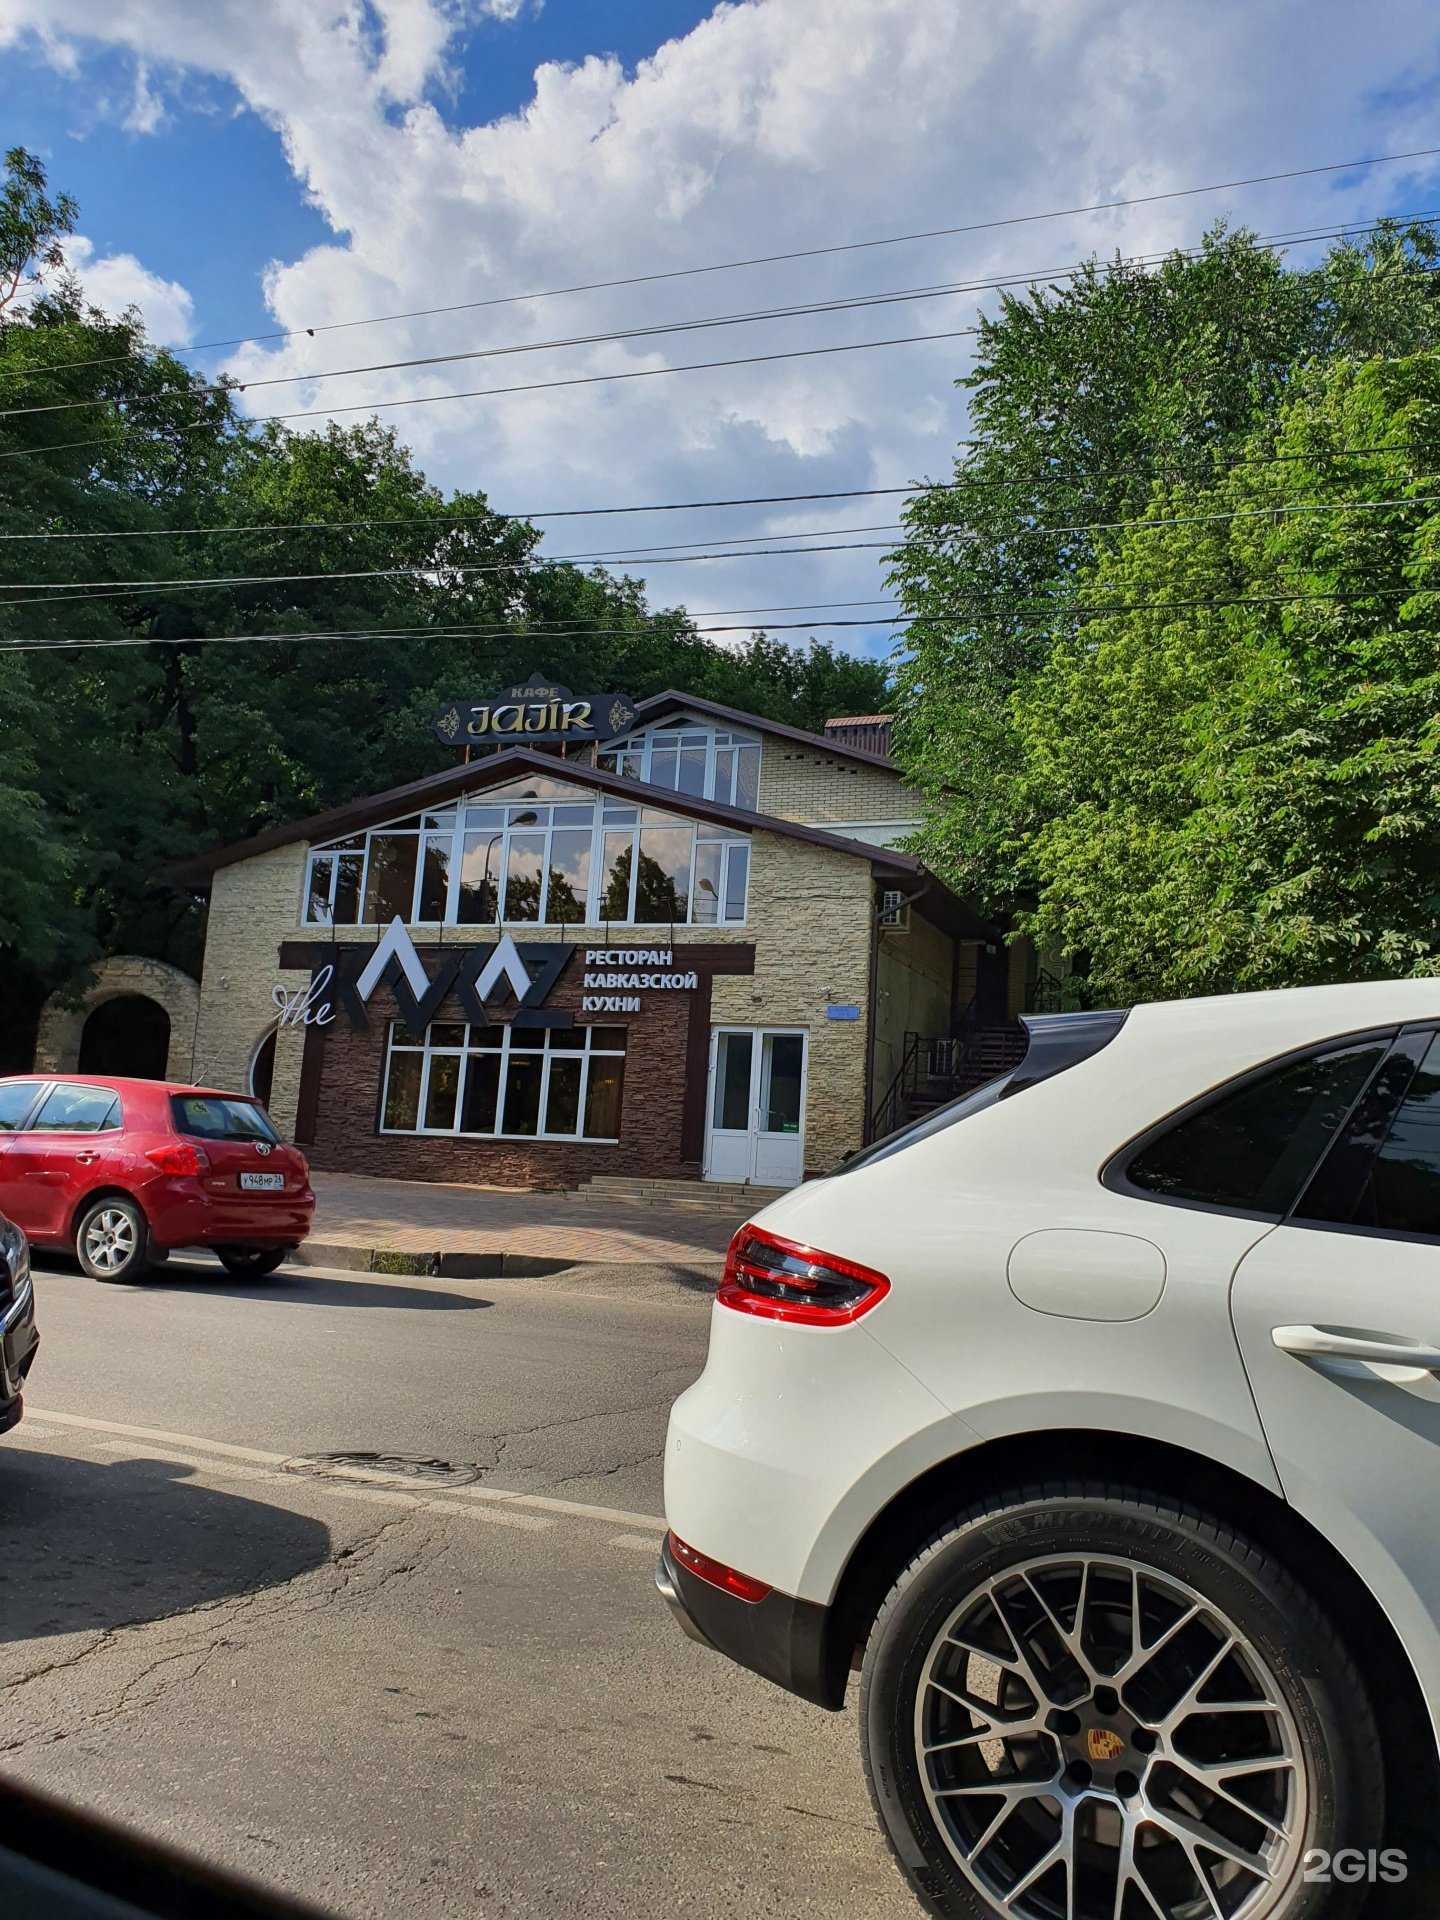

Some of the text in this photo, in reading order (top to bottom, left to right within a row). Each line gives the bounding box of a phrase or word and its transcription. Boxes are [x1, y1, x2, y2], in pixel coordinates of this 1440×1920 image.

[512, 687, 560, 698] КАФЕ
[585, 950, 674, 966] РЕСТОРАН
[583, 971, 699, 989] КАВКАЗСКОЙ
[582, 996, 641, 1013] КУХНИ
